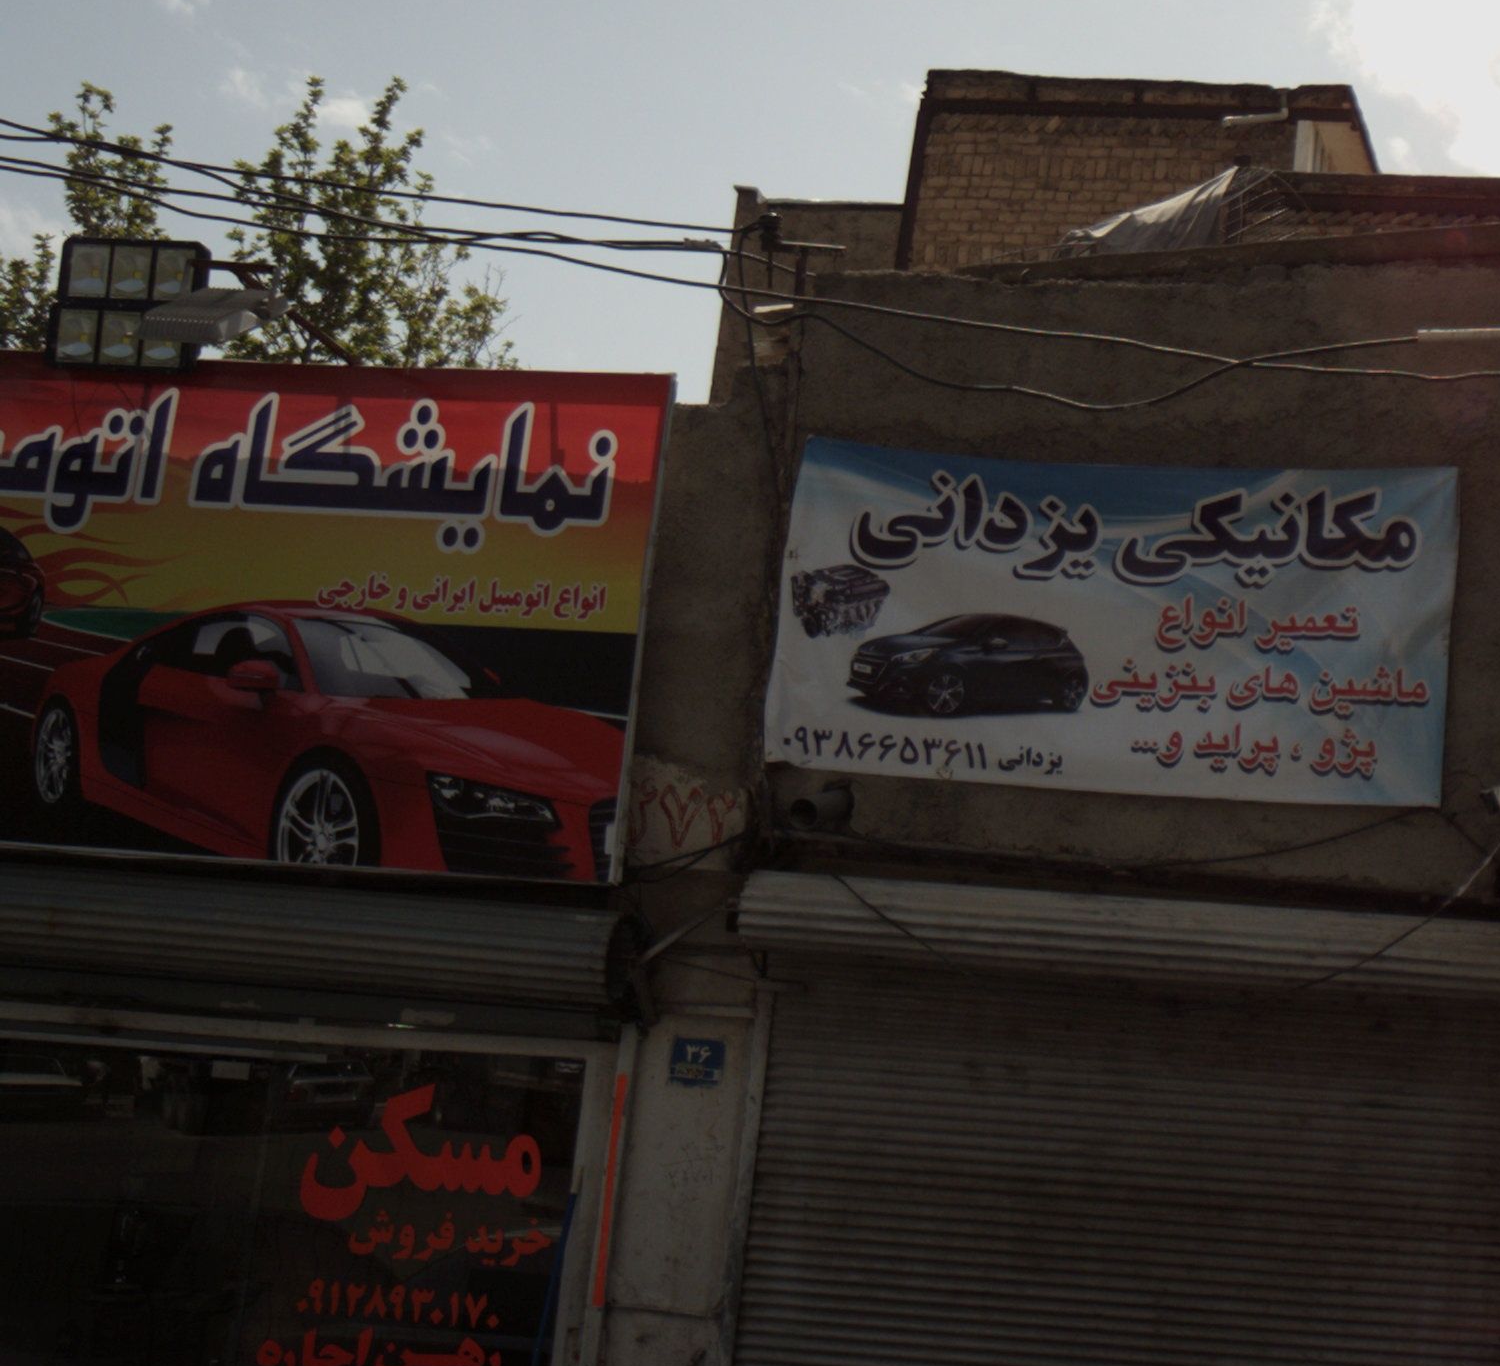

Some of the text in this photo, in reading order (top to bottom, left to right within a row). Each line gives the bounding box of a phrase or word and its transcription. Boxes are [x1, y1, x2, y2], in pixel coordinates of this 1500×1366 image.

[0, 387, 618, 553] نمایشگاه اتوم
[849, 468, 1419, 587] مکانیکی یزدانی
[316, 572, 607, 619] انواع اتومبیل ایرانی و خارجی
[1156, 594, 1361, 653] تعمیر انواع
[1090, 658, 1431, 718] ماشین های بنزینی
[998, 745, 1064, 775] یزدانی
[1193, 723, 1281, 773] پراید
[300, 1083, 542, 1221] مسکن
[349, 1209, 552, 1267] خرید فروش
